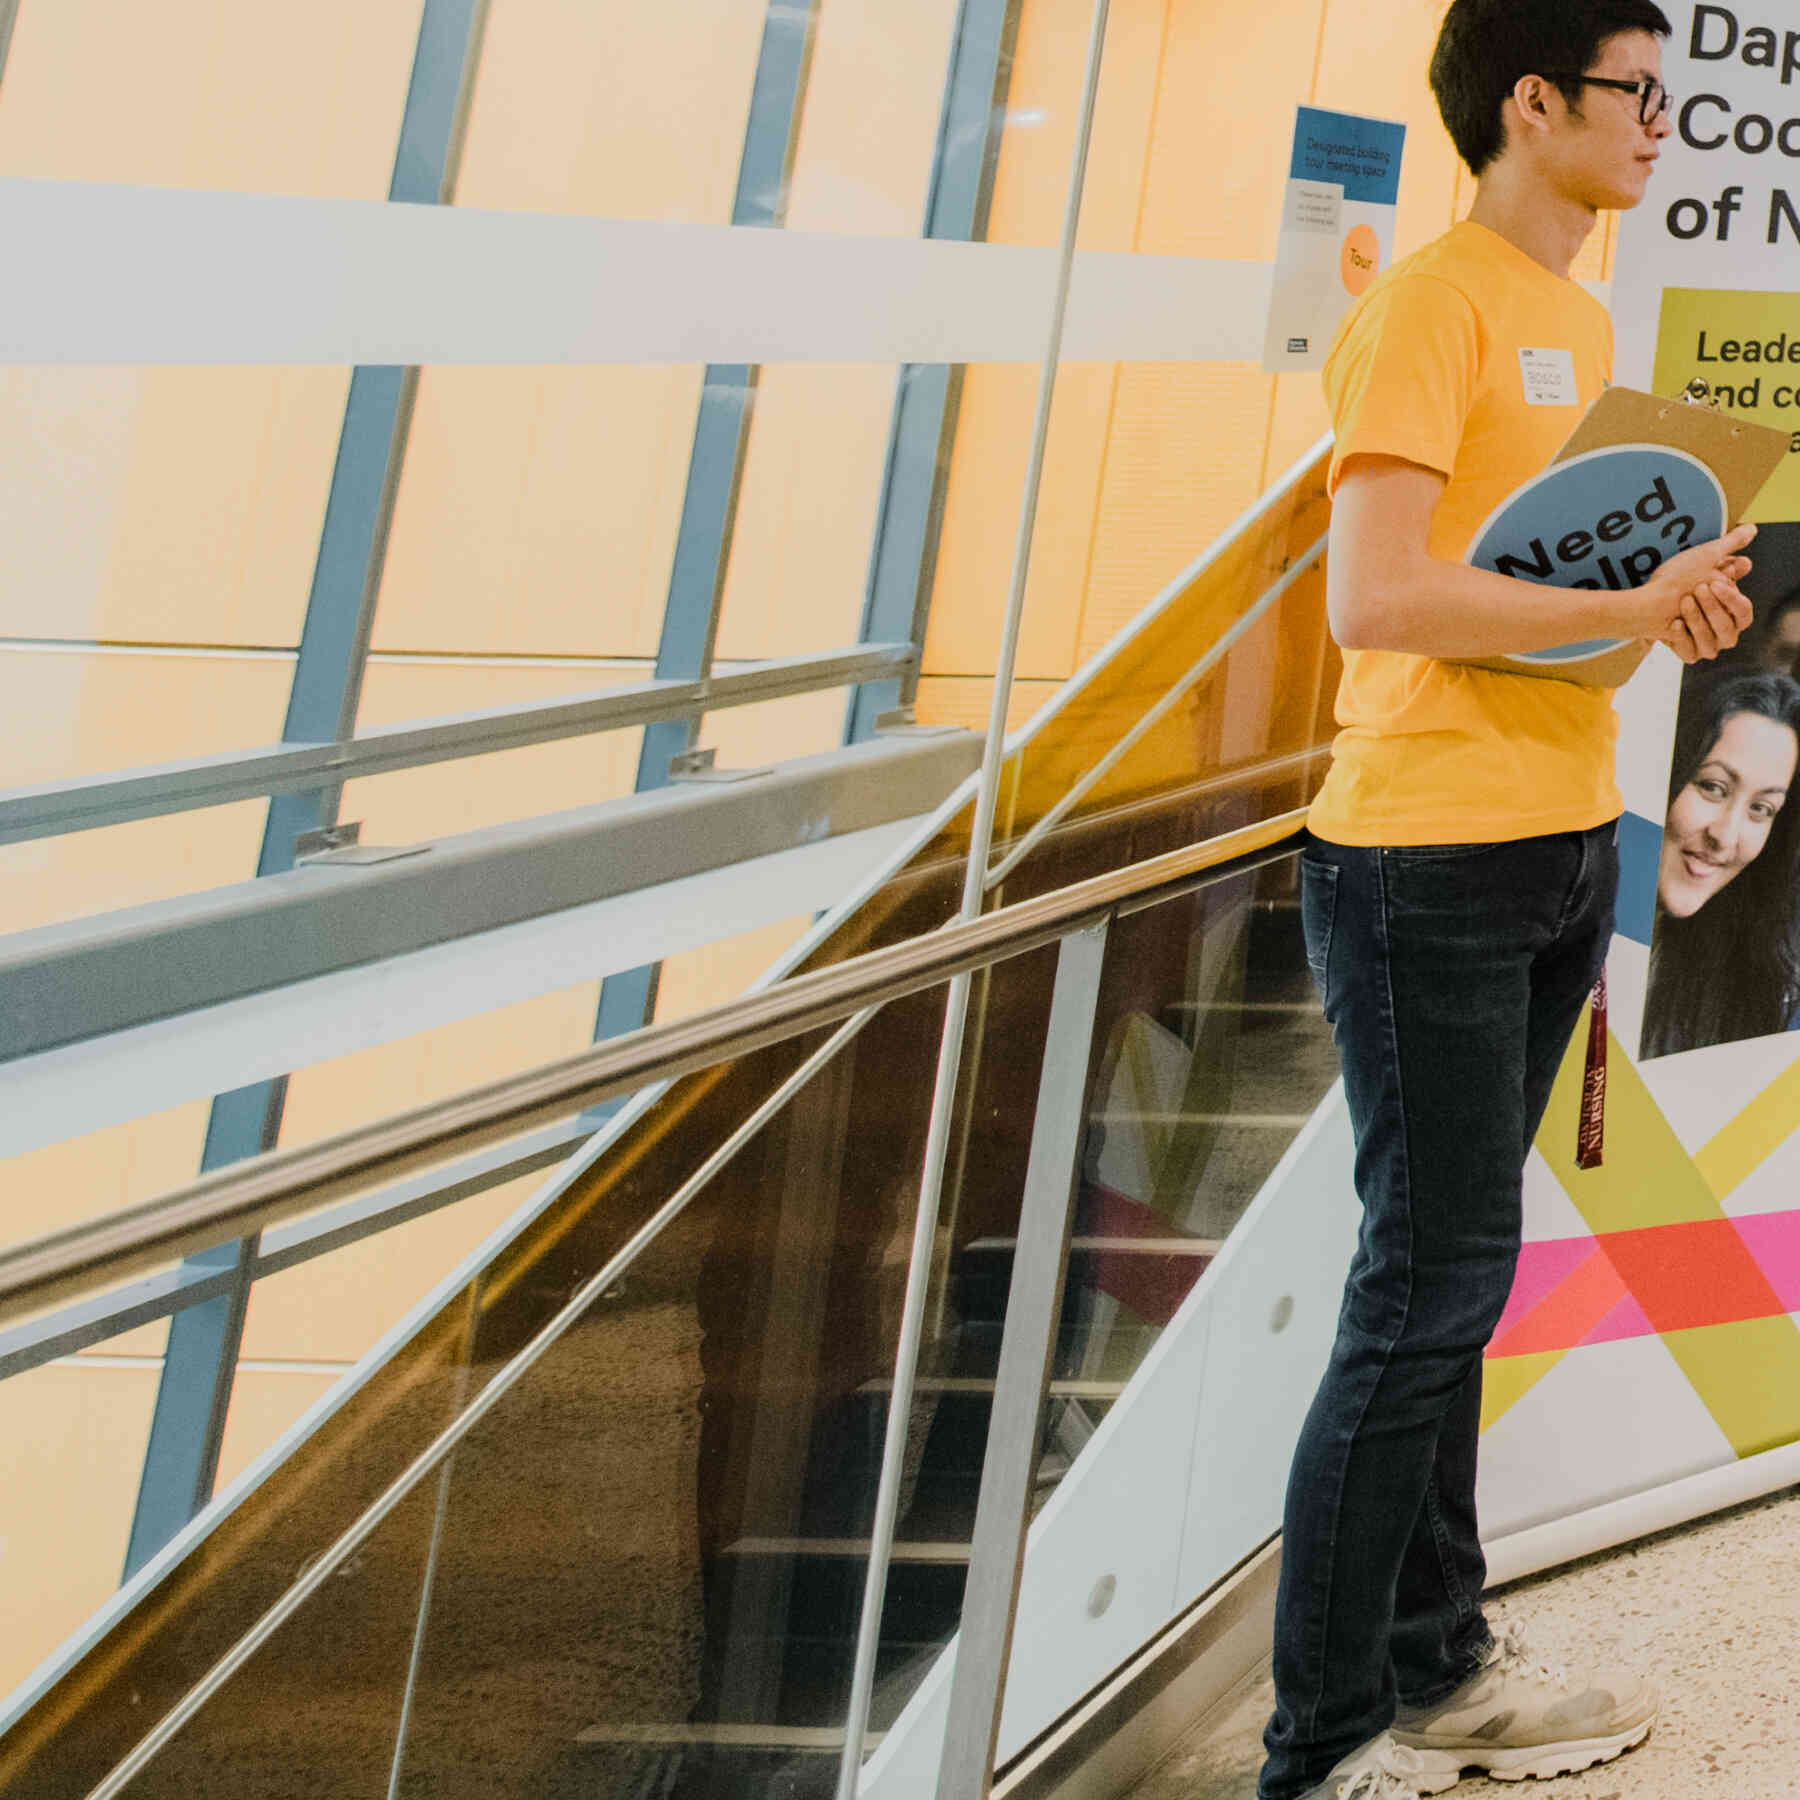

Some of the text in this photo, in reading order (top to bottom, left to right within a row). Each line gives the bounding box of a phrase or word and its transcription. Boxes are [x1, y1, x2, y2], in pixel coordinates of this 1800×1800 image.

[1664, 186, 1743, 242] of
[1350, 248, 1373, 271] Tour
[1690, 378, 1760, 408] nd
[1494, 476, 1677, 579] Need
[1569, 515, 1695, 591] lp?
[1588, 1066, 1605, 1150] NURSING
